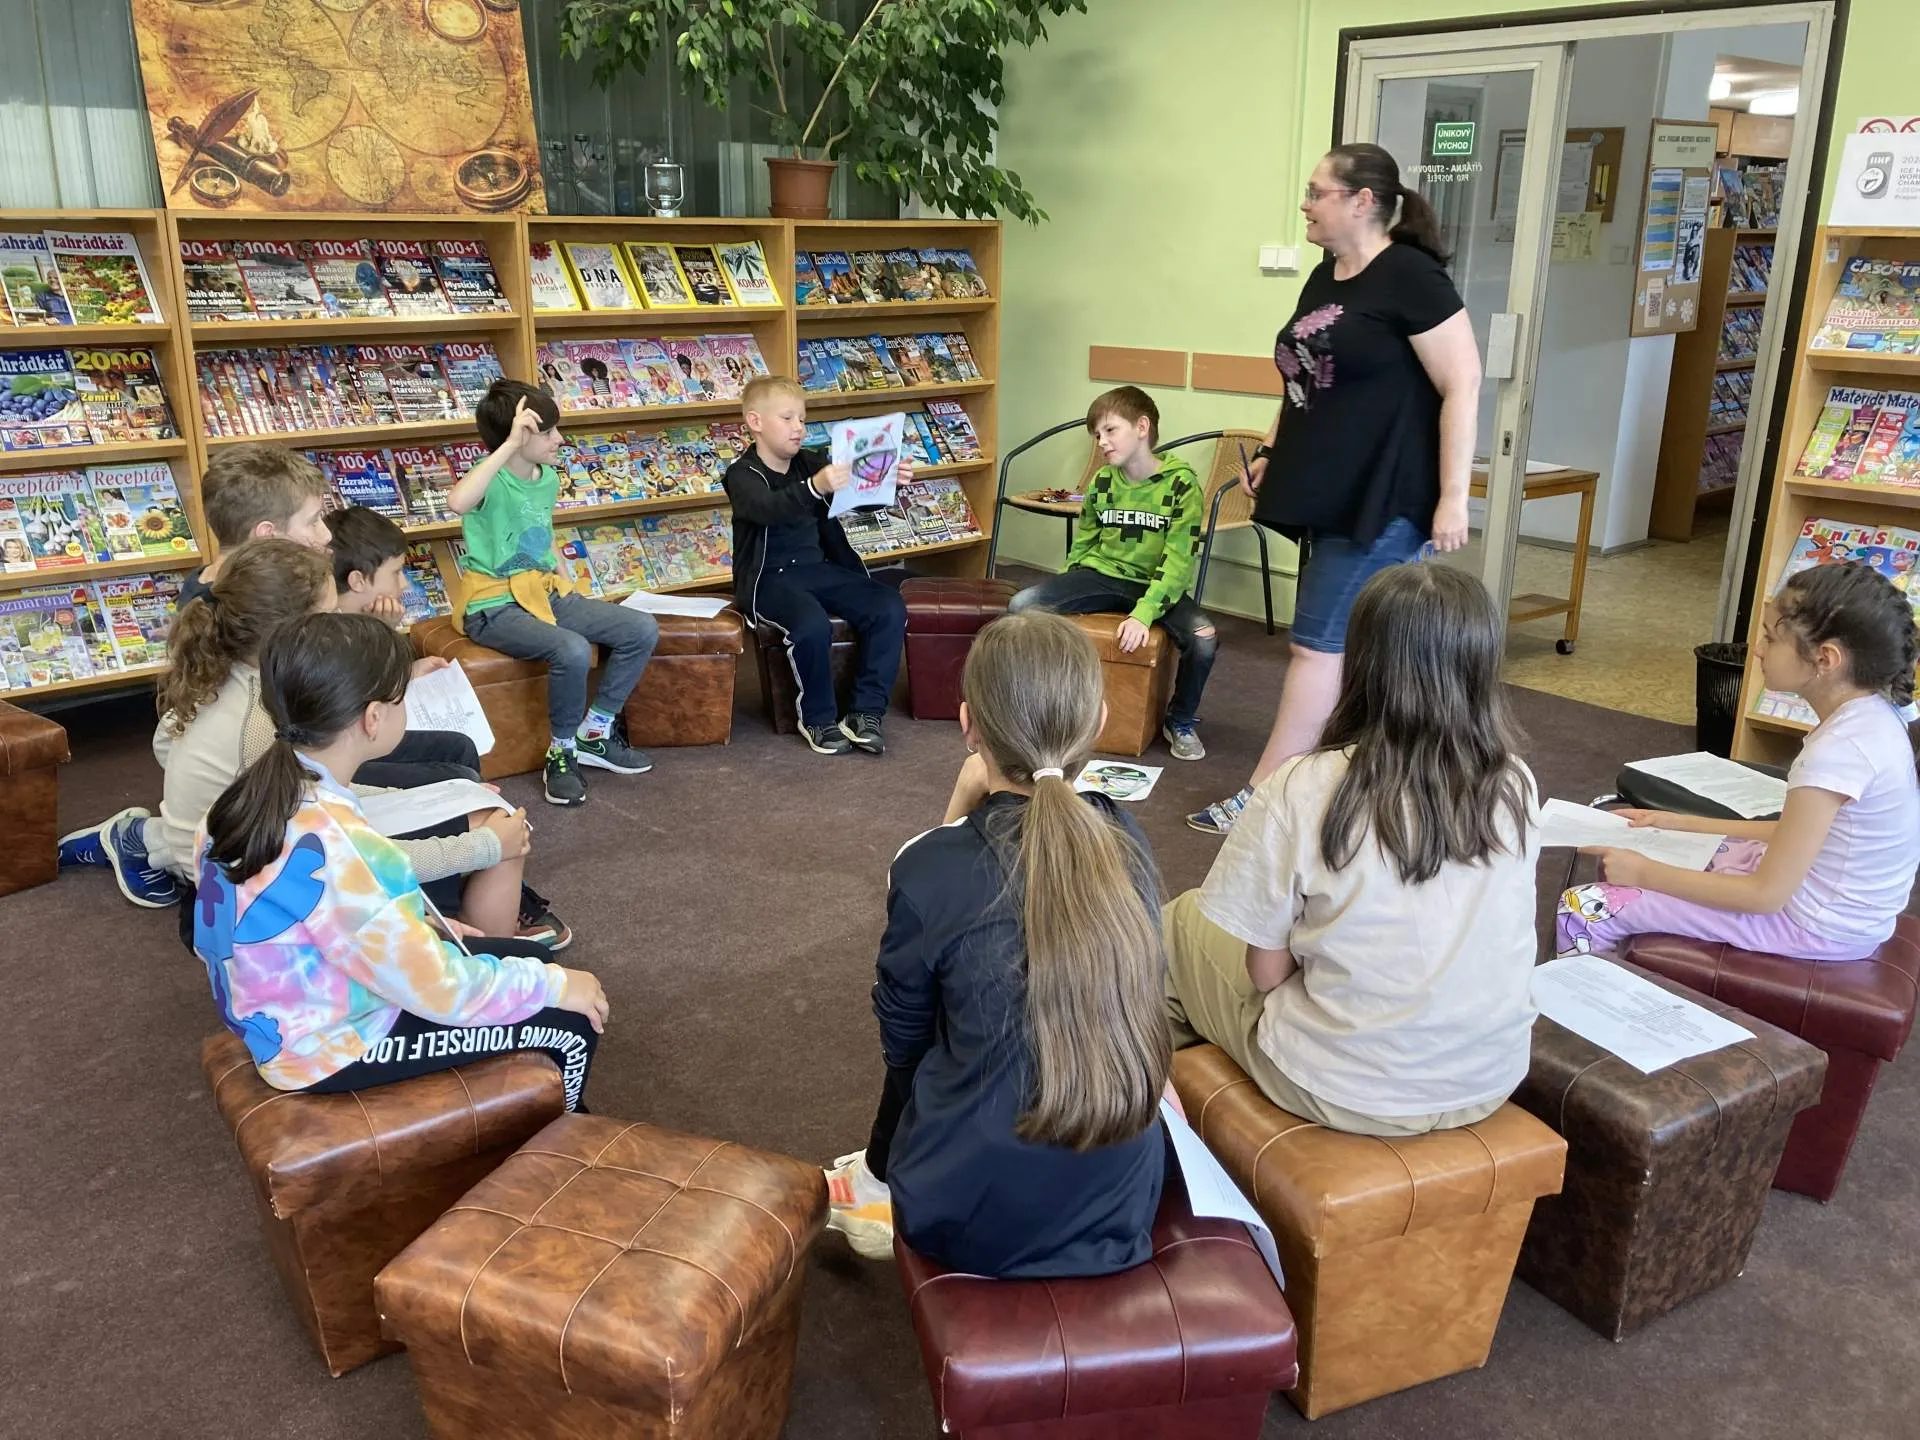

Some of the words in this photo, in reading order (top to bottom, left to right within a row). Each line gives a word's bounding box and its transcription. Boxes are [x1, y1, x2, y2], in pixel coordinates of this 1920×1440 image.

[1438, 128, 1471, 137] ÚNIKOVÝ
[1438, 140, 1469, 150] VÝCHOD
[50, 234, 125, 250] zahrádkář
[244, 241, 295, 256] 100+1
[314, 240, 362, 256] 100+1
[379, 240, 424, 255] 100+1
[436, 241, 479, 255] 100+1
[579, 267, 621, 283] DNA
[208, 289, 236, 298] druhu
[208, 297, 242, 306] sapiens
[384, 346, 427, 359] 100+1
[445, 343, 487, 357] 100+1
[712, 339, 747, 358] Barbie
[73, 351, 152, 371] 2000
[337, 455, 383, 470] 100+1
[394, 449, 438, 465] 100+1
[95, 467, 168, 488] Receptář
[337, 477, 374, 488] Zázraky
[341, 485, 376, 495] lidského
[920, 519, 945, 530] Stalin
[408, 1026, 513, 1060] YOURSELF
